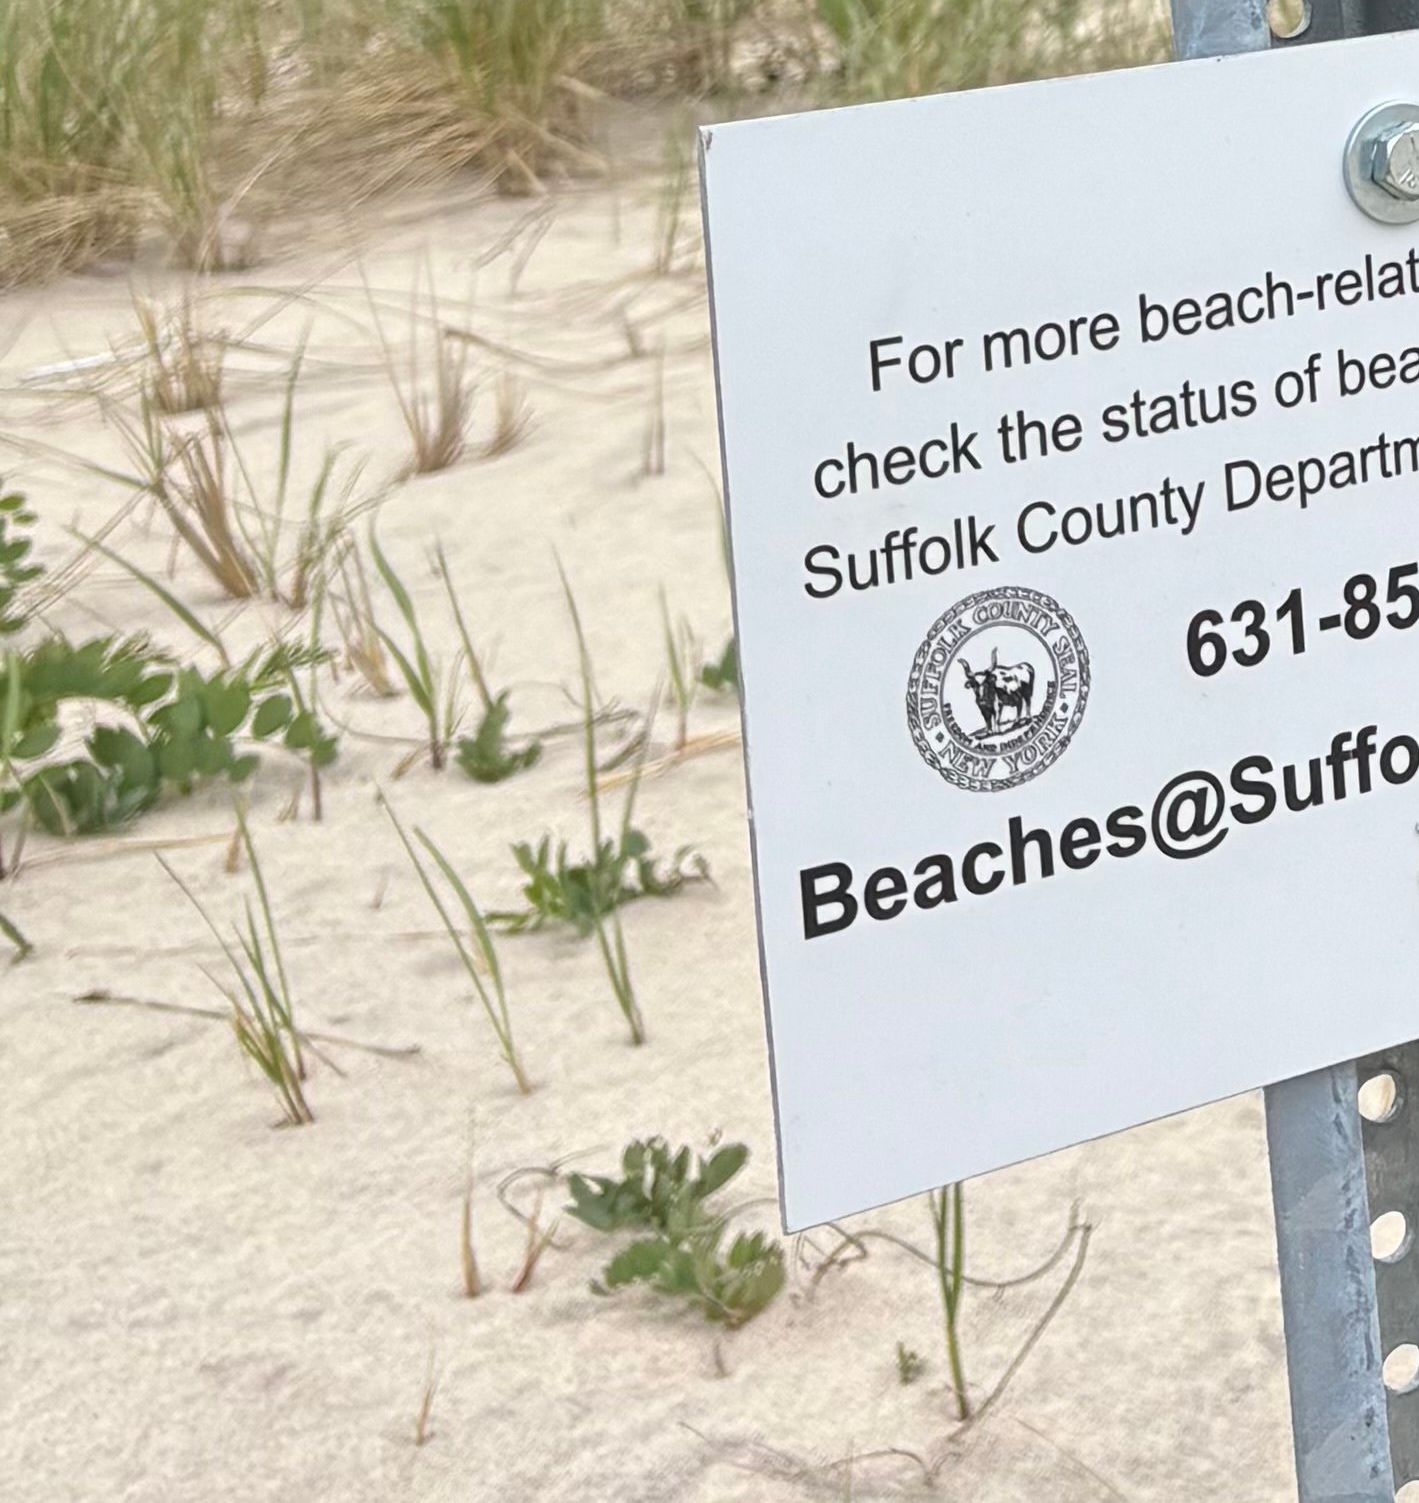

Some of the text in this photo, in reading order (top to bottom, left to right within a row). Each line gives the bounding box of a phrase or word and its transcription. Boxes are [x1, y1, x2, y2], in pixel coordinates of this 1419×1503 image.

[870, 337, 963, 391] For
[984, 314, 1119, 371] more
[815, 423, 981, 498] check
[998, 411, 1081, 463] the
[1103, 381, 1256, 442] status
[1276, 353, 1321, 407] of
[805, 516, 998, 598] Suffolk
[1018, 478, 1204, 553] County
[920, 617, 972, 731] SUFFOLK
[972, 601, 1060, 637] COUNTY
[1052, 635, 1078, 699] SEAL
[938, 741, 997, 778] NEW
[1002, 711, 1068, 774] YORK
